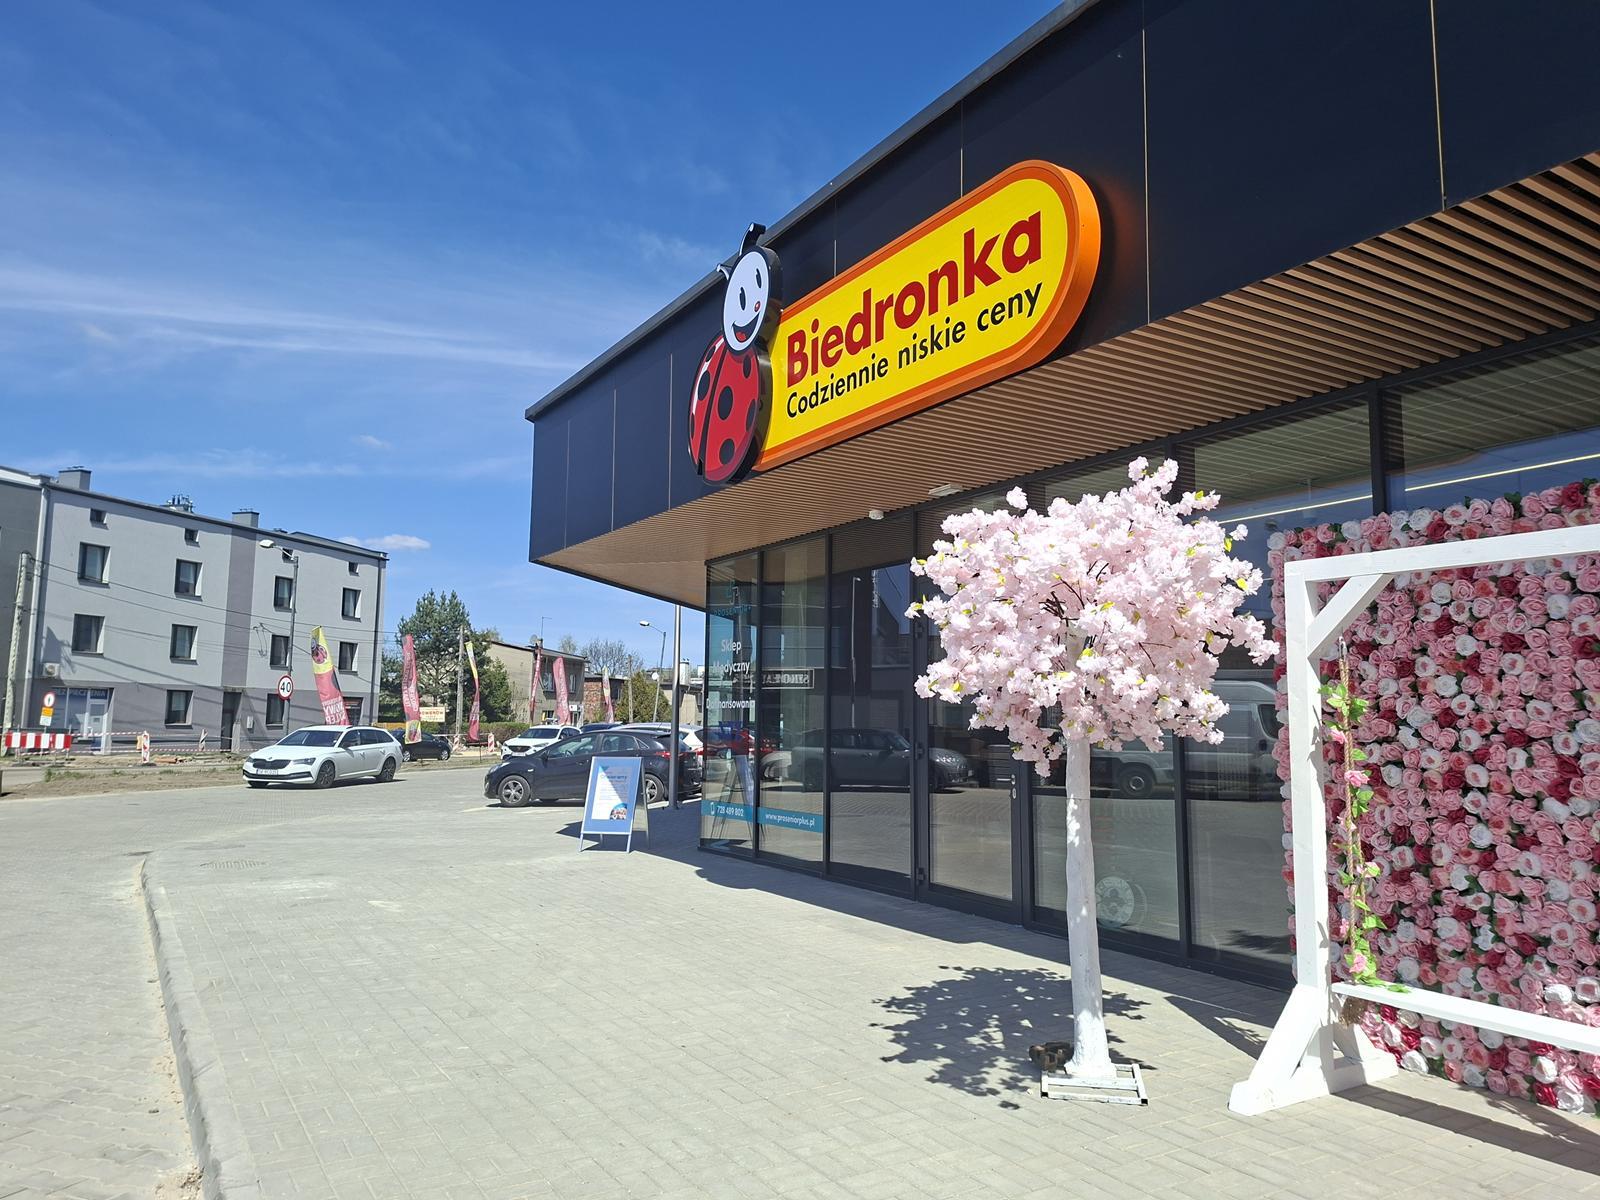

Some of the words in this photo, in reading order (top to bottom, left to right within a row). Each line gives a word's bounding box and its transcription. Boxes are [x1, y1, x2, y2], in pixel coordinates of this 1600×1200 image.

[787, 211, 1041, 388] Biedronka
[787, 352, 889, 417] Codziennie
[898, 321, 966, 368] niskie
[977, 282, 1043, 331] ceny
[721, 639, 742, 654] Sklep
[280, 681, 291, 692] 40
[765, 813, 815, 828] www.proseniorplus.pl
